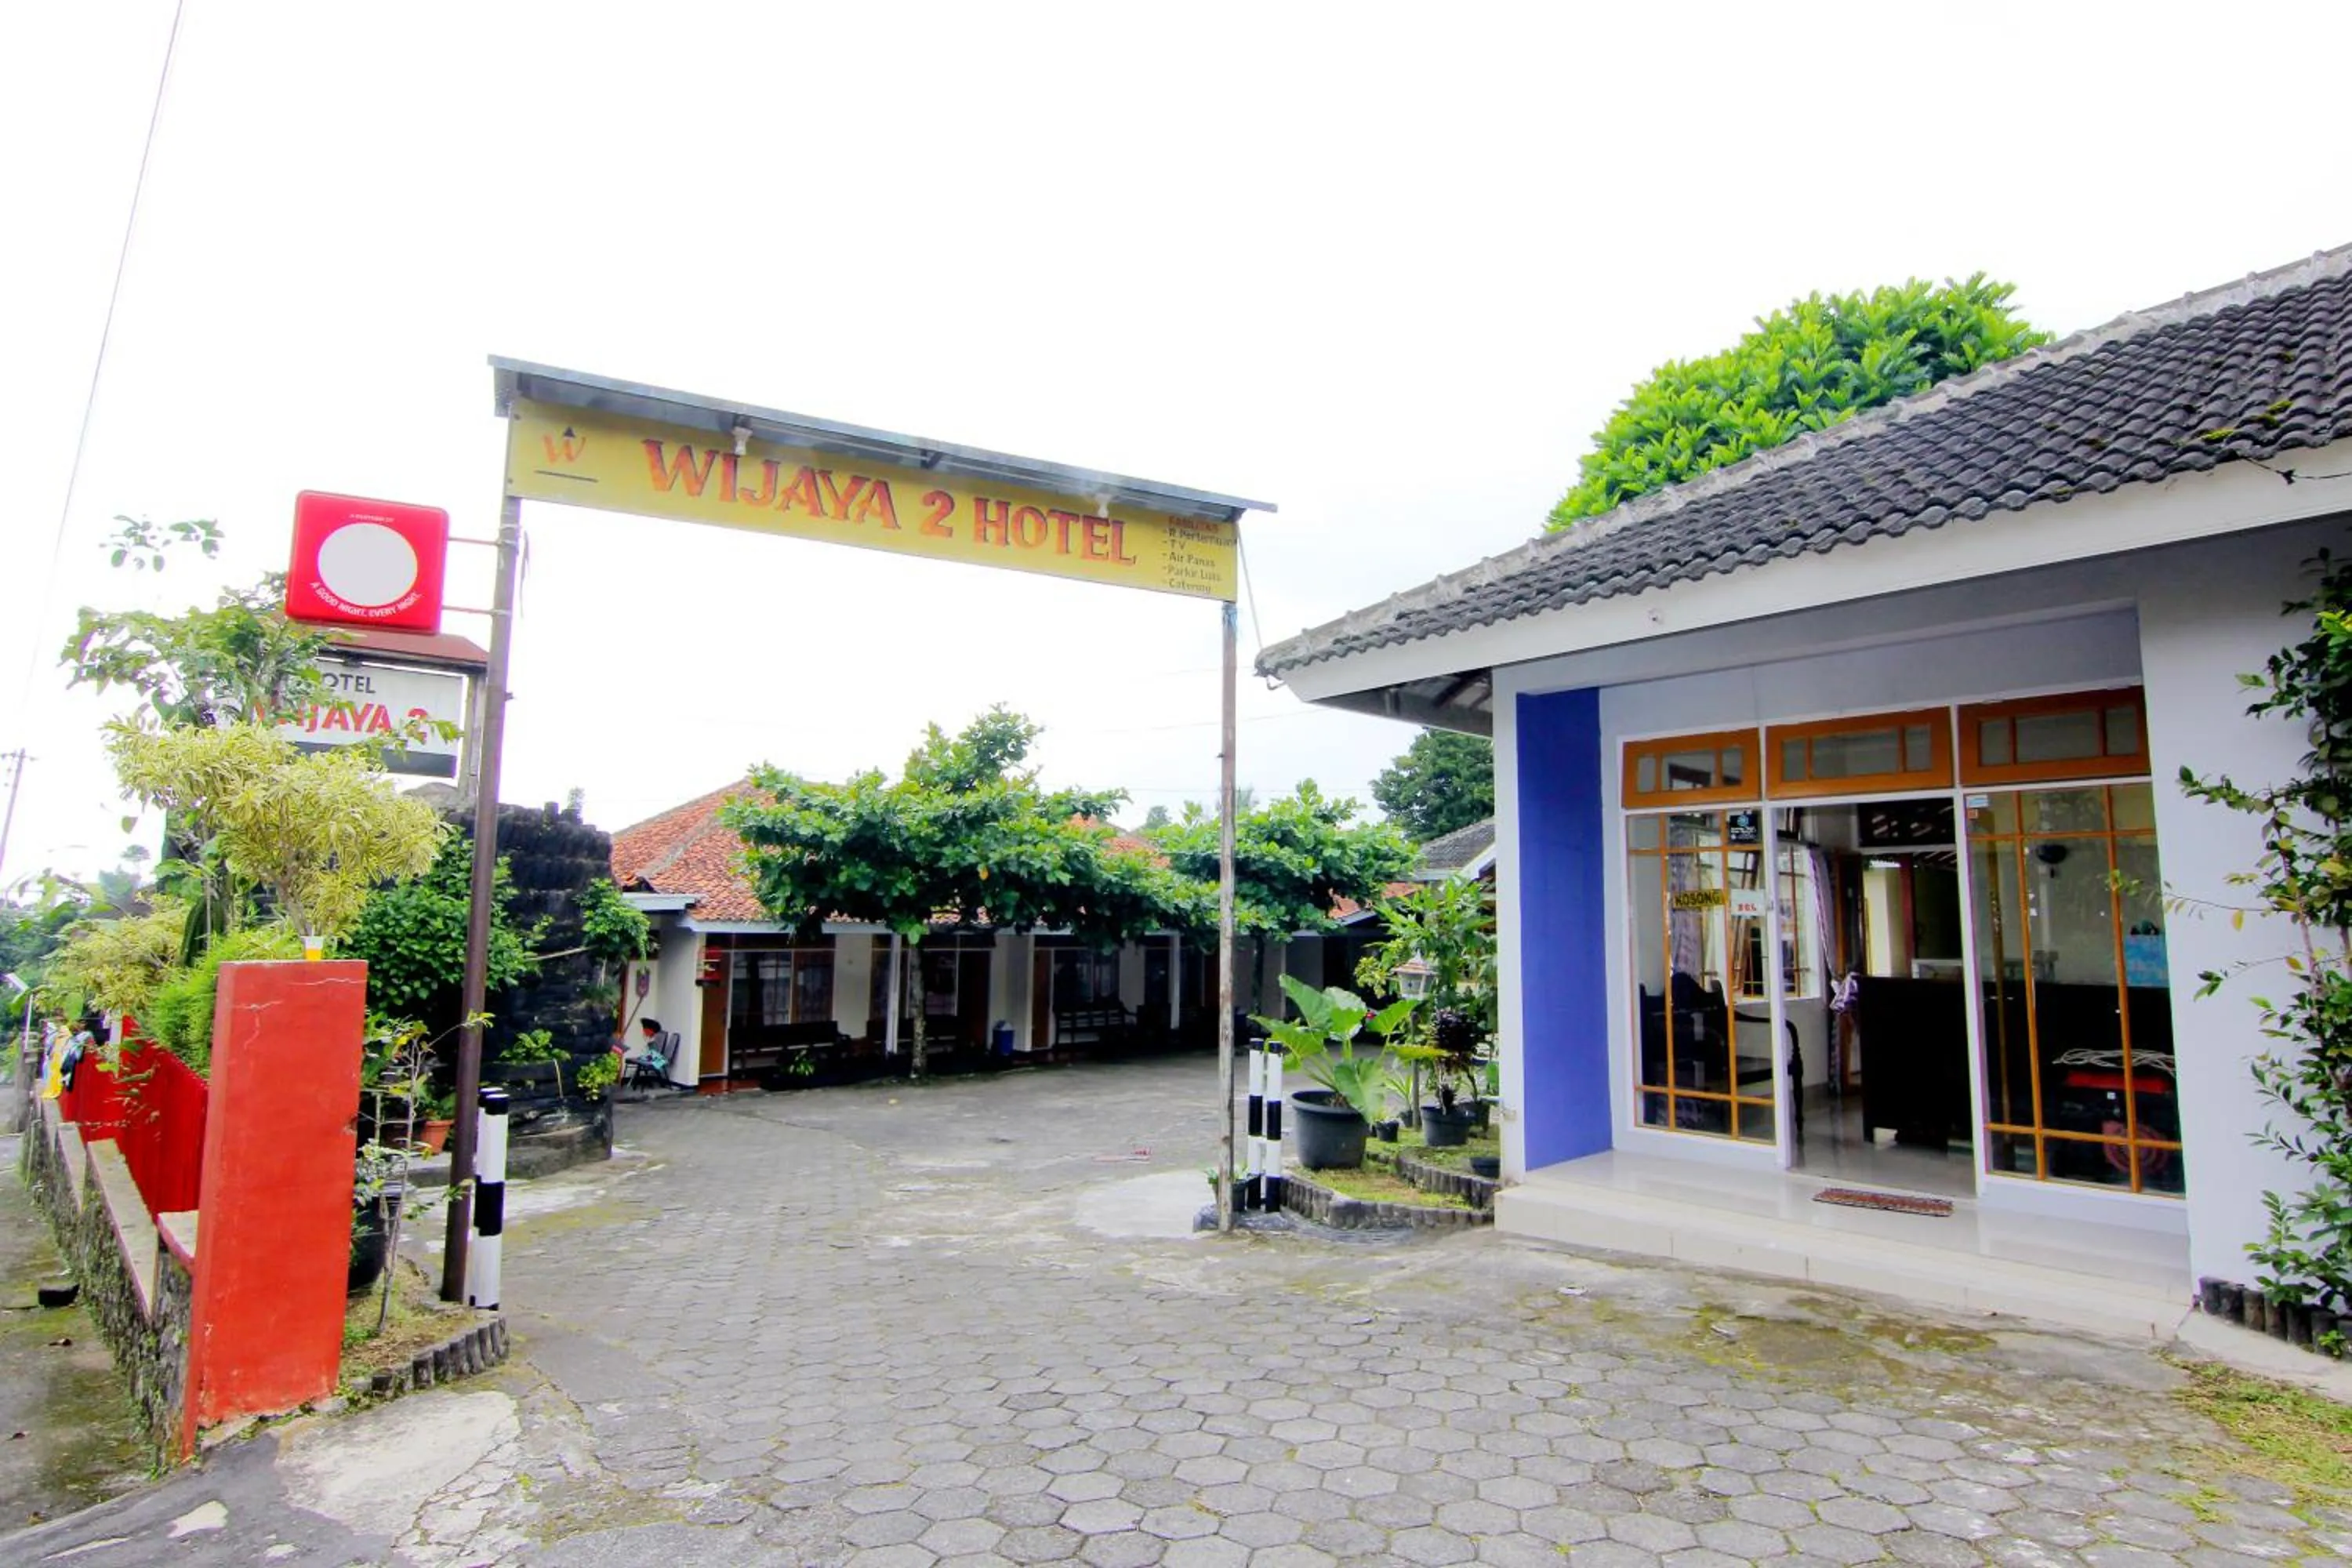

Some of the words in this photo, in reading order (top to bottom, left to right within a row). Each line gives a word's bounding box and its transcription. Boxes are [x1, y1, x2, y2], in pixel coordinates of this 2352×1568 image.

[641, 437, 902, 530] WIJAYA
[920, 489, 956, 539] 2
[972, 496, 1137, 567] HOTEL
[315, 587, 339, 607] GOOD
[368, 608, 397, 617] EVERY
[321, 672, 376, 694] OTEL
